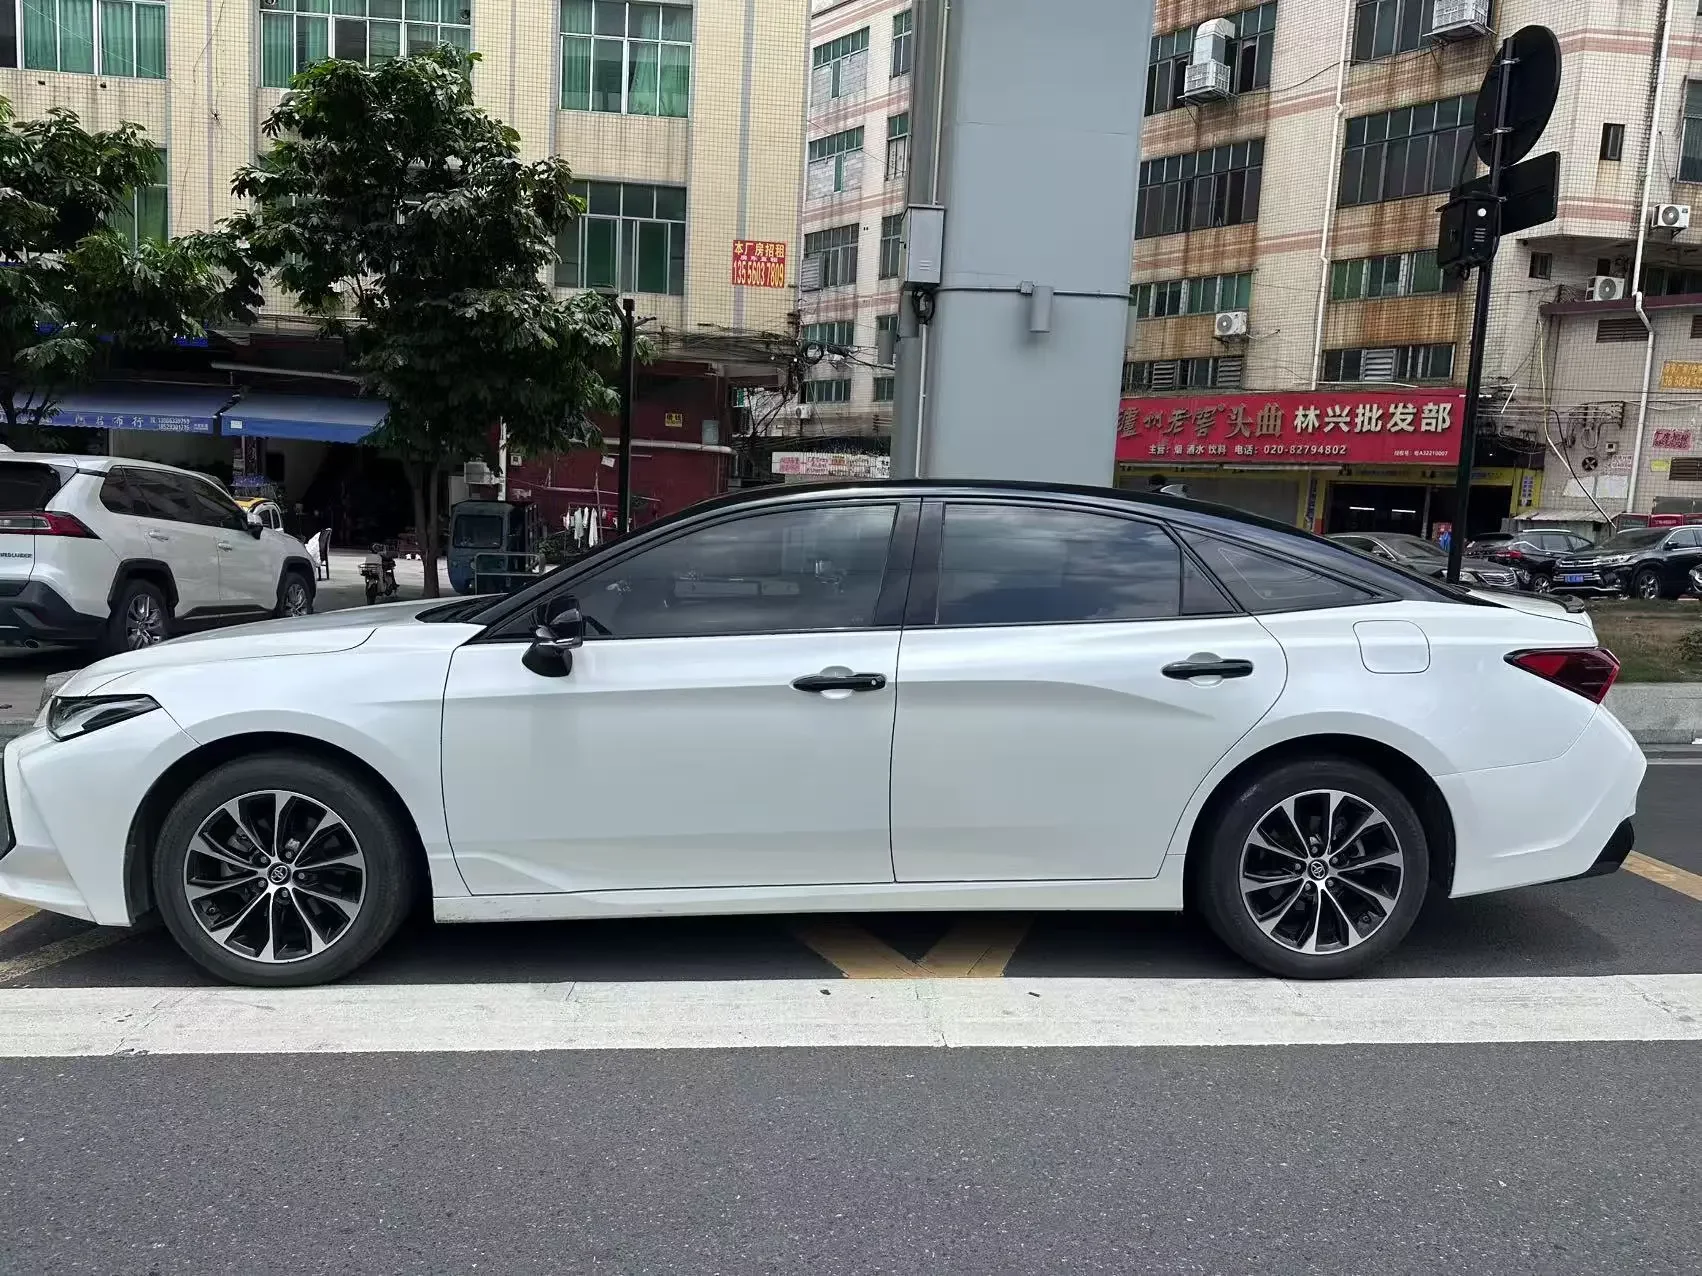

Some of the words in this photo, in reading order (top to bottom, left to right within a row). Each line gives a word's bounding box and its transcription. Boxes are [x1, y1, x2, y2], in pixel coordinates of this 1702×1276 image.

[734, 241, 785, 258] 本厂房招租
[1294, 402, 1452, 433] 林兴批发部
[1263, 444, 1347, 455] 020-82794802
